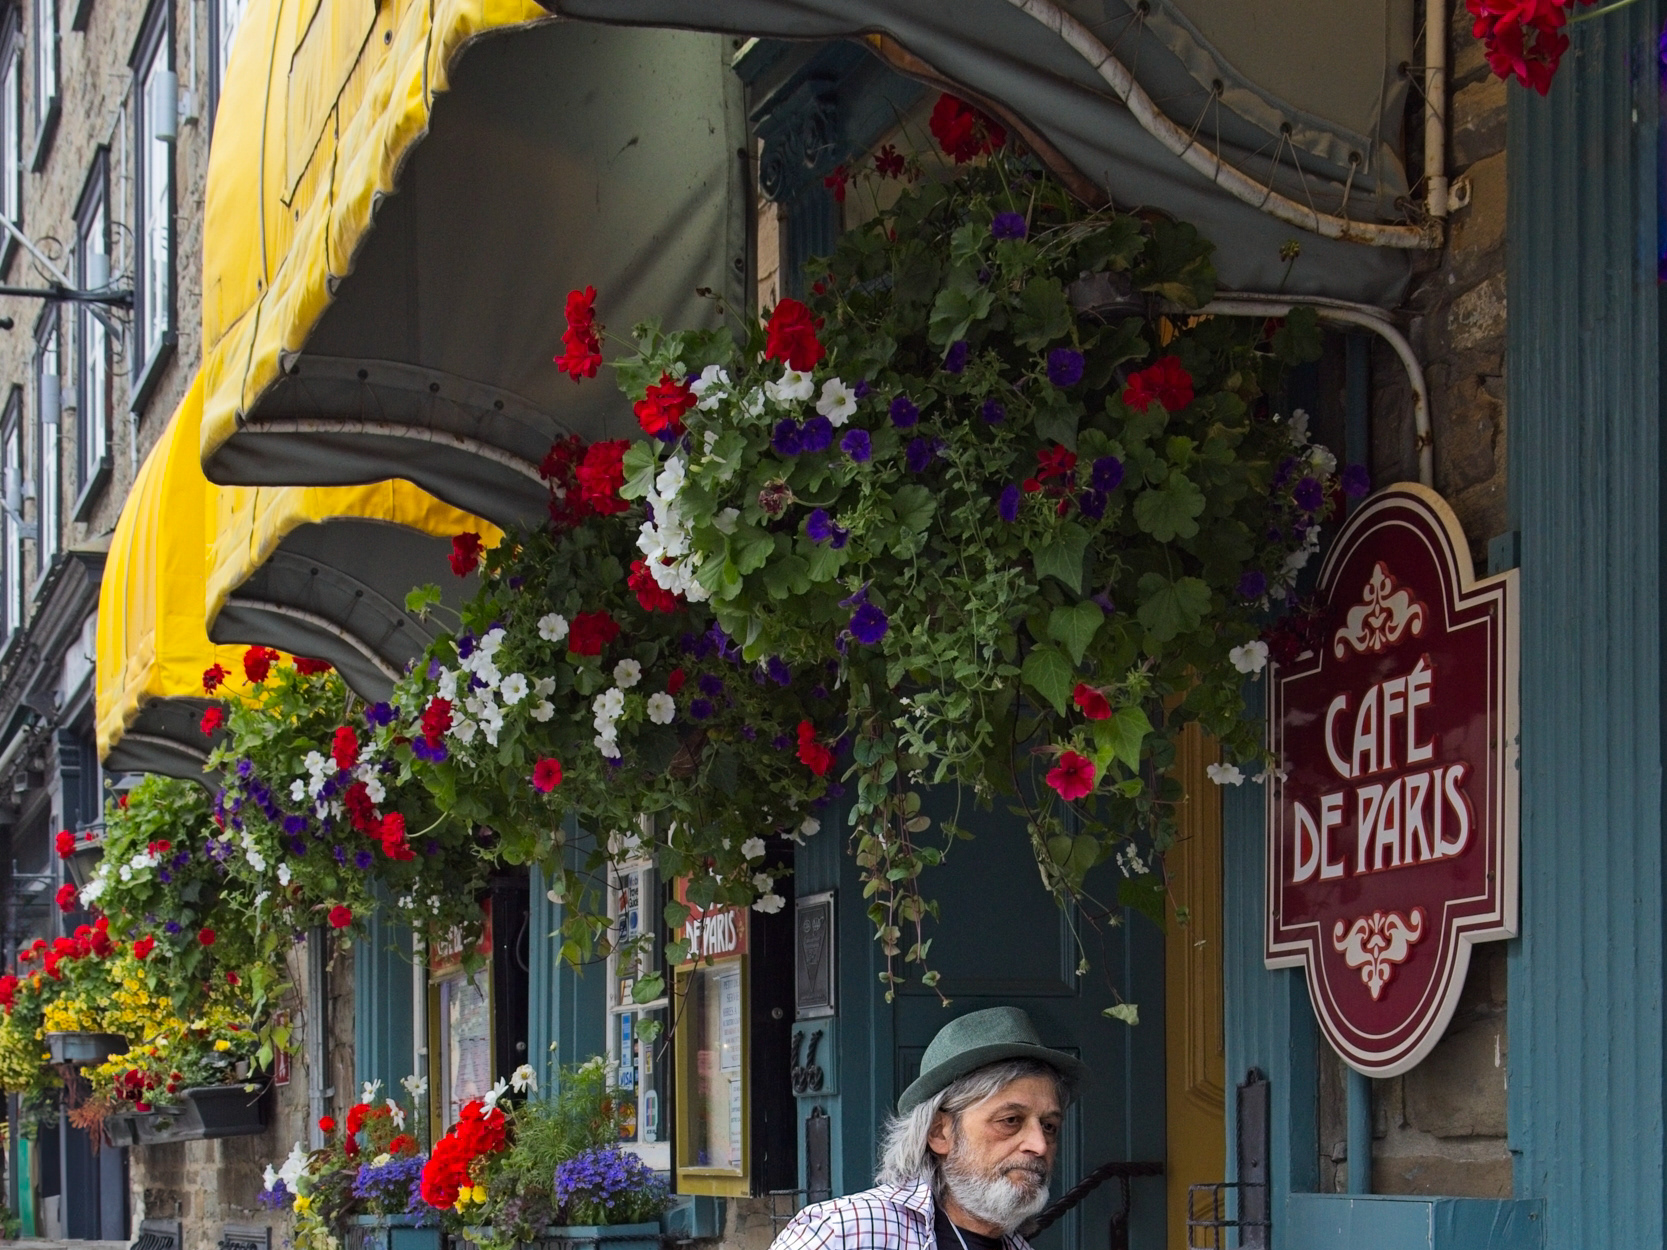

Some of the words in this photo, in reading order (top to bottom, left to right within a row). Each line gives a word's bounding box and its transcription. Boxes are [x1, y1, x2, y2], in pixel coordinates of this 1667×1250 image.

[1324, 656, 1434, 778] CAFÉ
[1293, 793, 1346, 882] DE
[1356, 765, 1469, 875] PARIS
[685, 919, 702, 959] DE
[703, 910, 737, 956] PARIS
[620, 1072, 632, 1086] VISA
